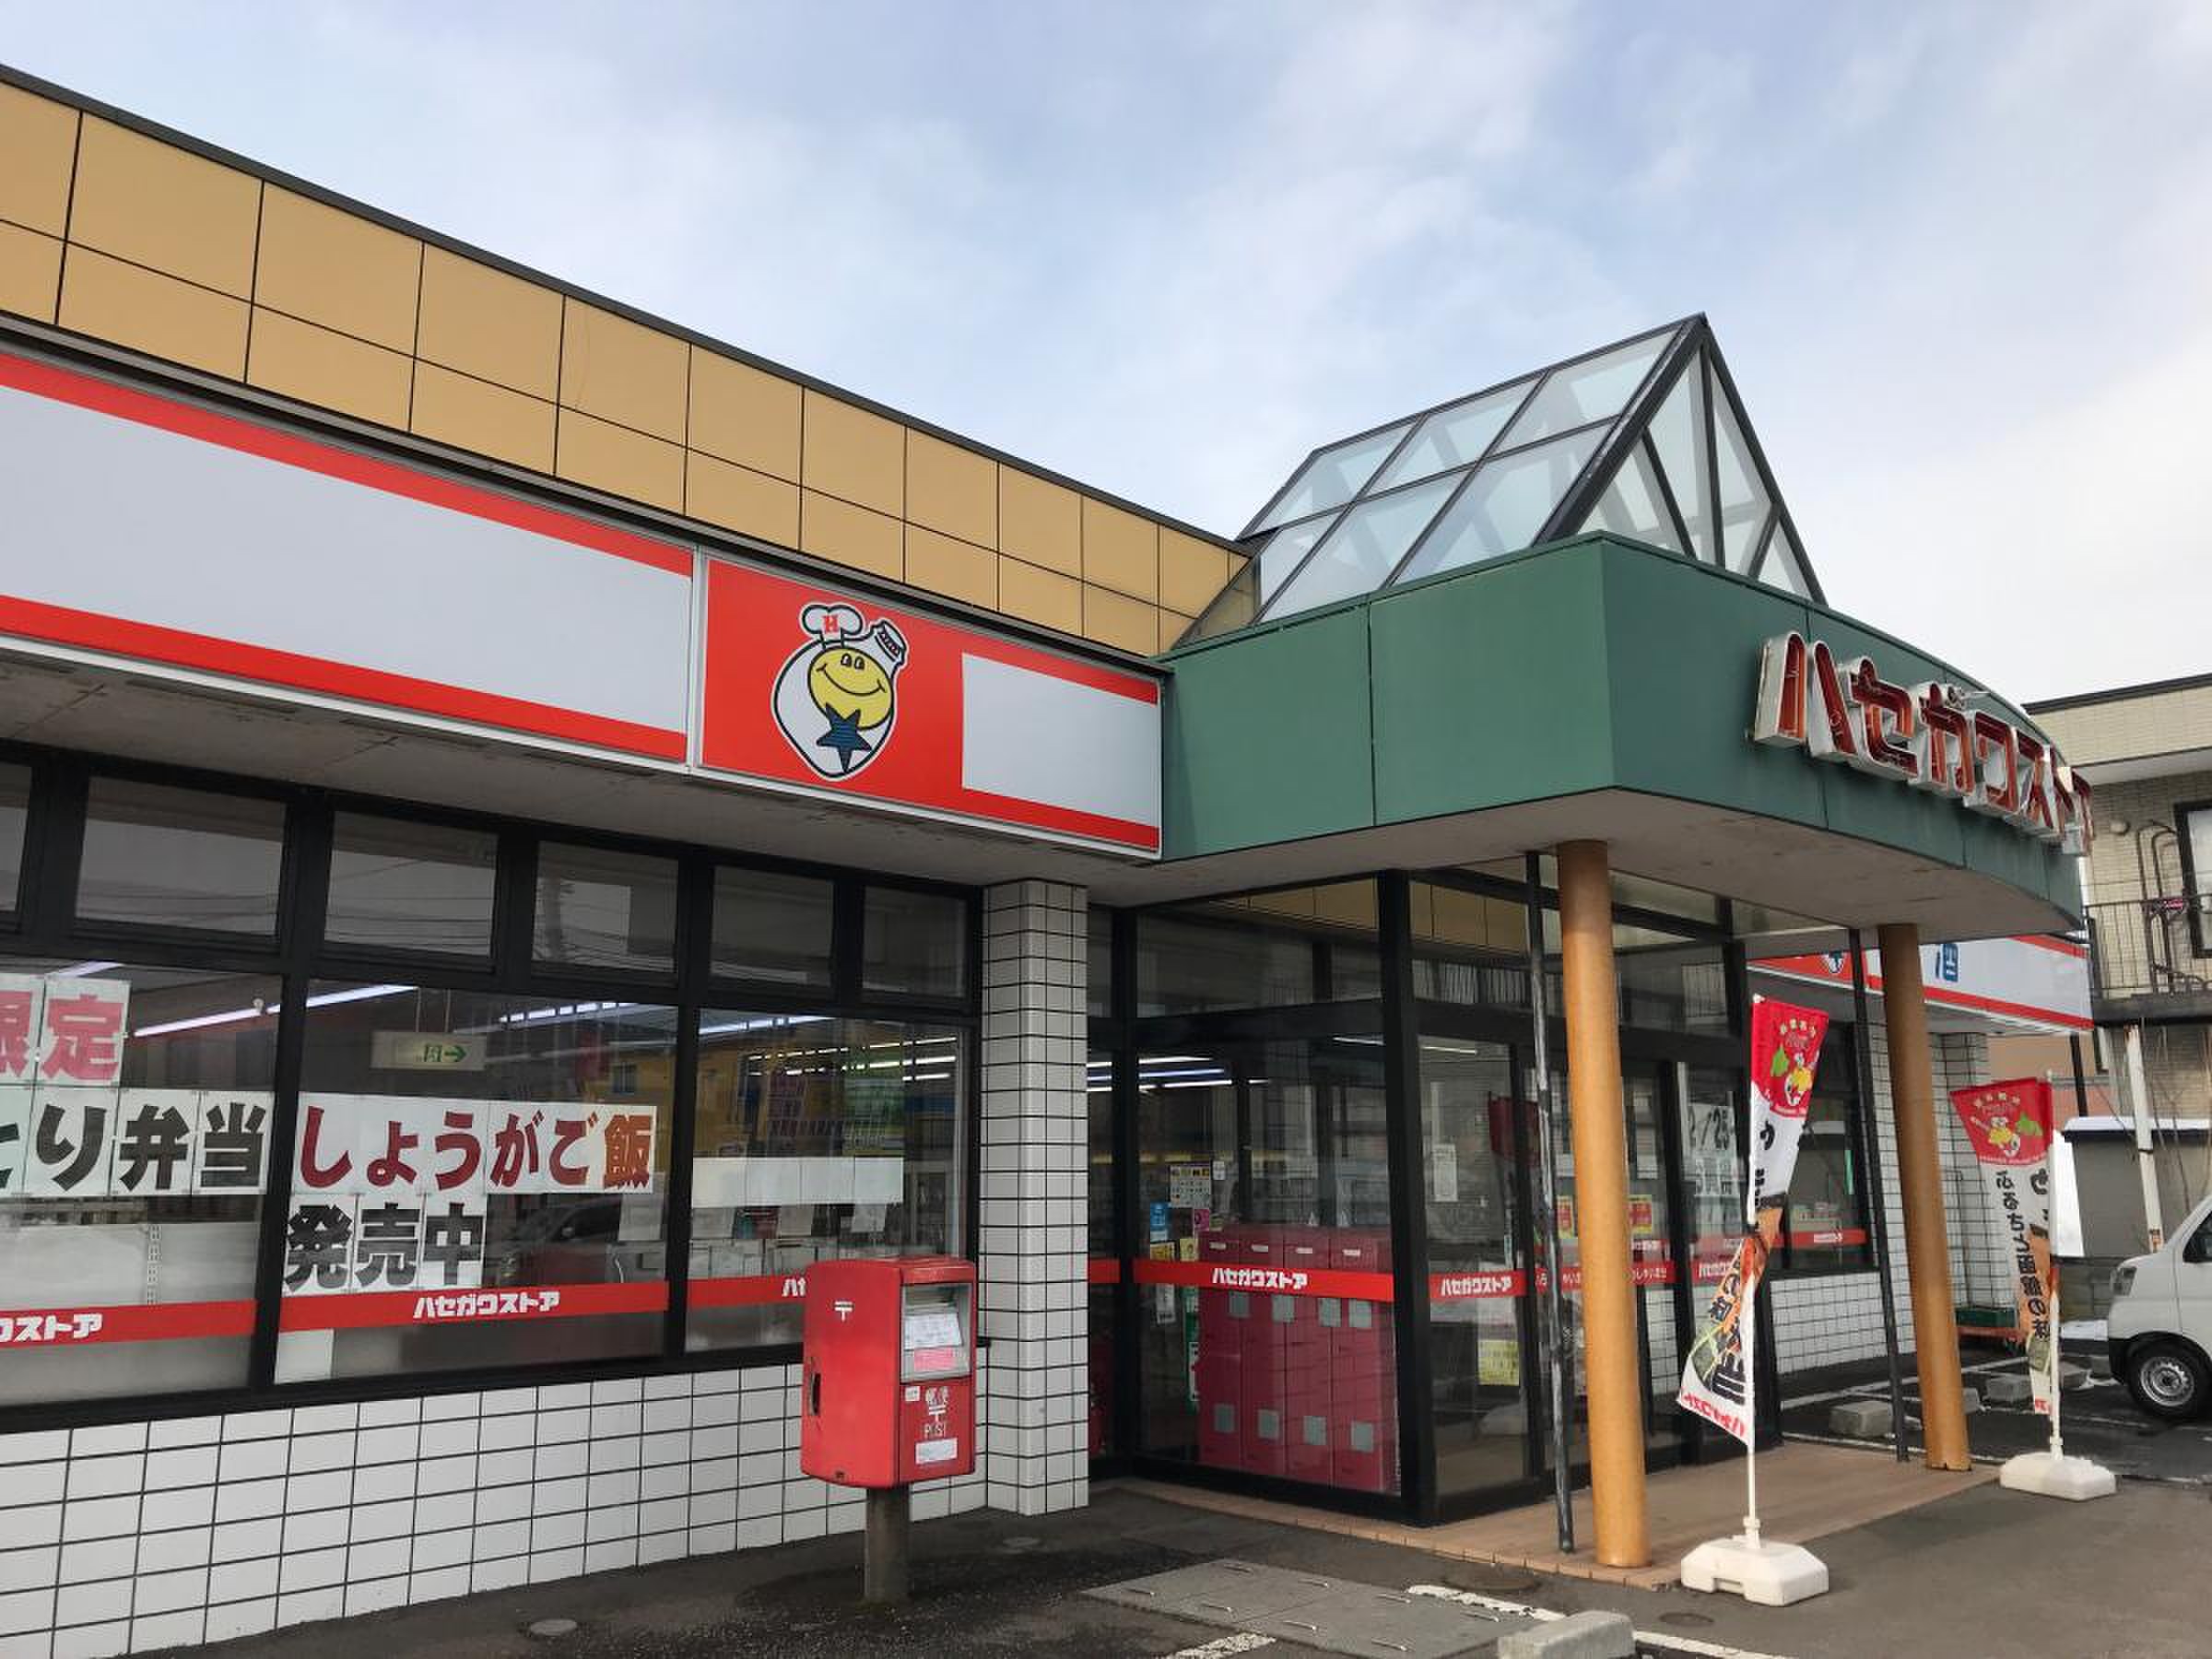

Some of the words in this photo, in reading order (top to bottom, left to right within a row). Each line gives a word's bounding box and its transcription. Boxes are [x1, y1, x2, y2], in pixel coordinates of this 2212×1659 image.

[0, 1102, 266, 1191] り弁当
[300, 1105, 653, 1191] しょうがご飯
[283, 1202, 485, 1289] 発売中
[1212, 1267, 1308, 1289] ハセガワストア
[1441, 1276, 1512, 1296] ハセガワストア
[413, 1291, 560, 1319] ハセガワストア
[0, 1313, 103, 1344] ストア
